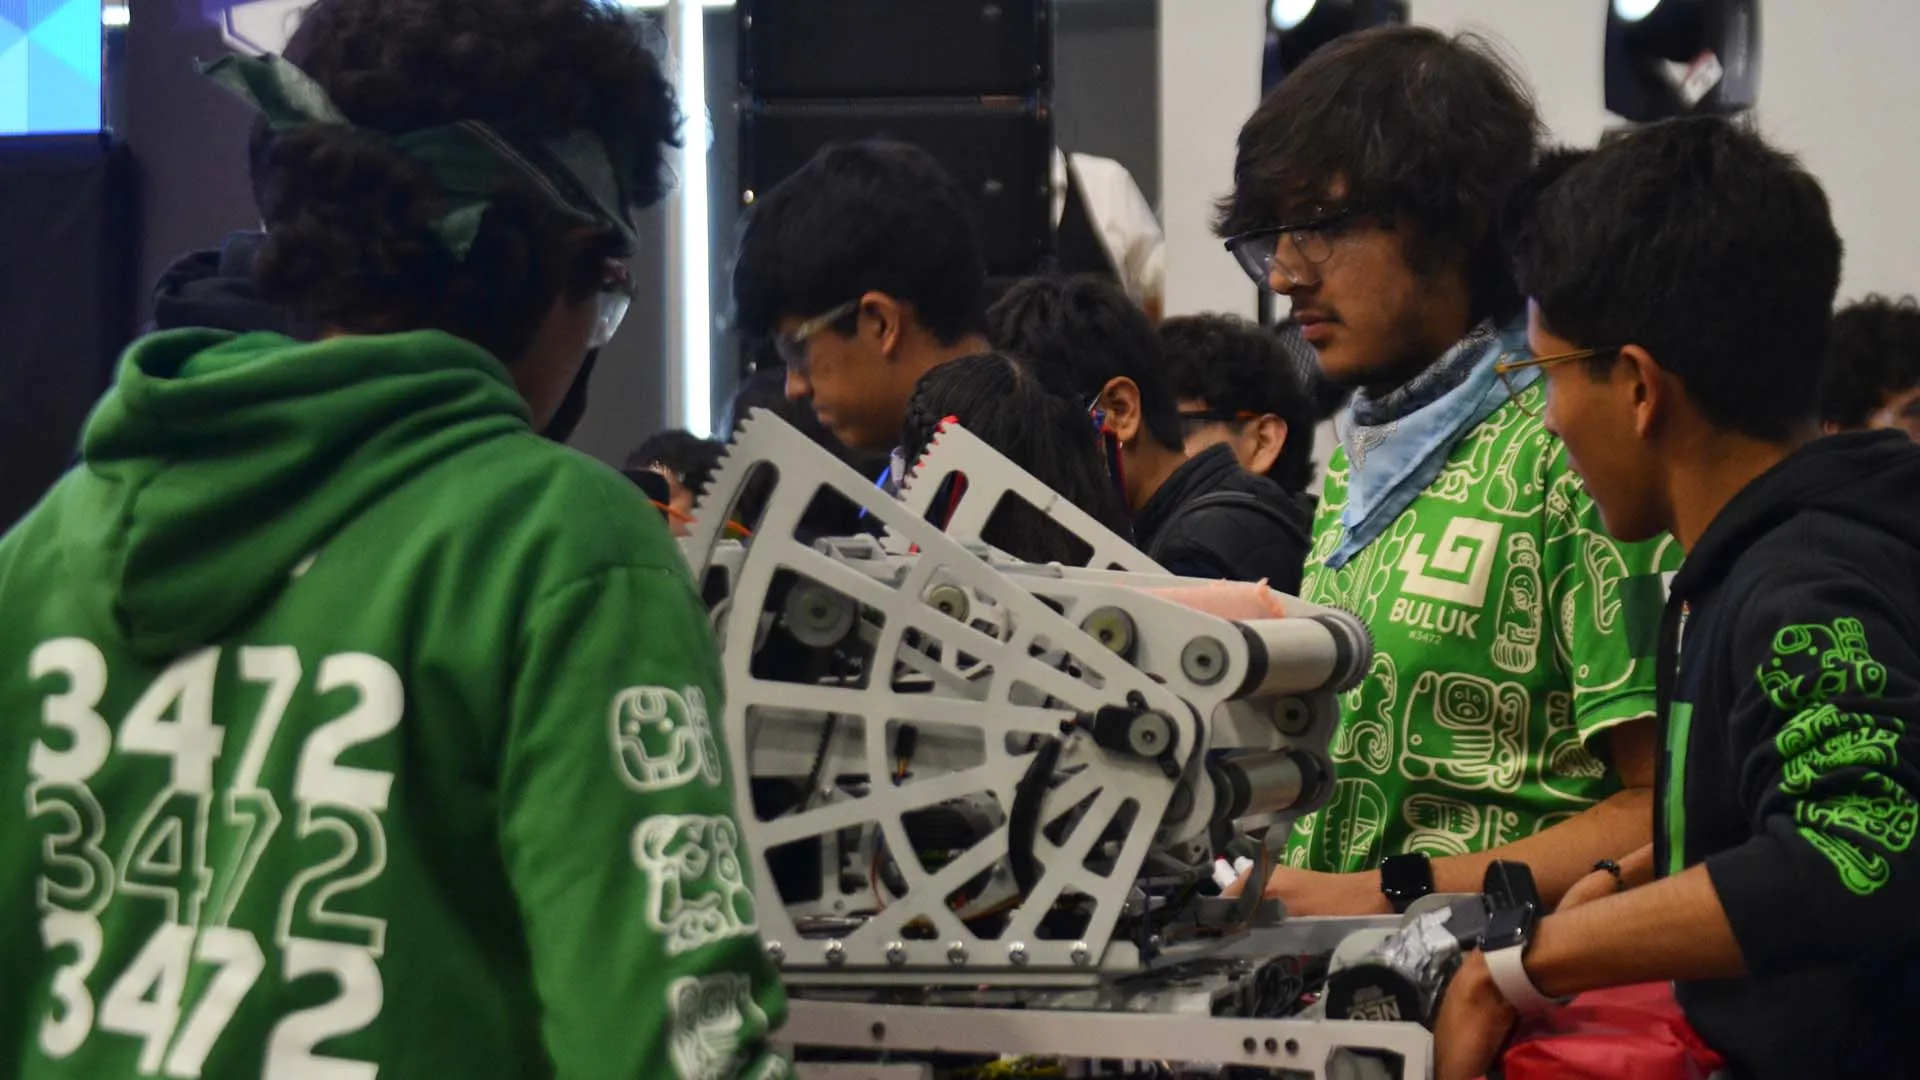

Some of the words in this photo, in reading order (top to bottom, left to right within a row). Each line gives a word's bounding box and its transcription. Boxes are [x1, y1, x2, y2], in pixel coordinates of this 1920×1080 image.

[1389, 597, 1480, 639] BULUK
[1408, 630, 1442, 645] #3472
[28, 637, 404, 811] 3472
[26, 778, 388, 958] 3472
[39, 912, 384, 1080] 3472
